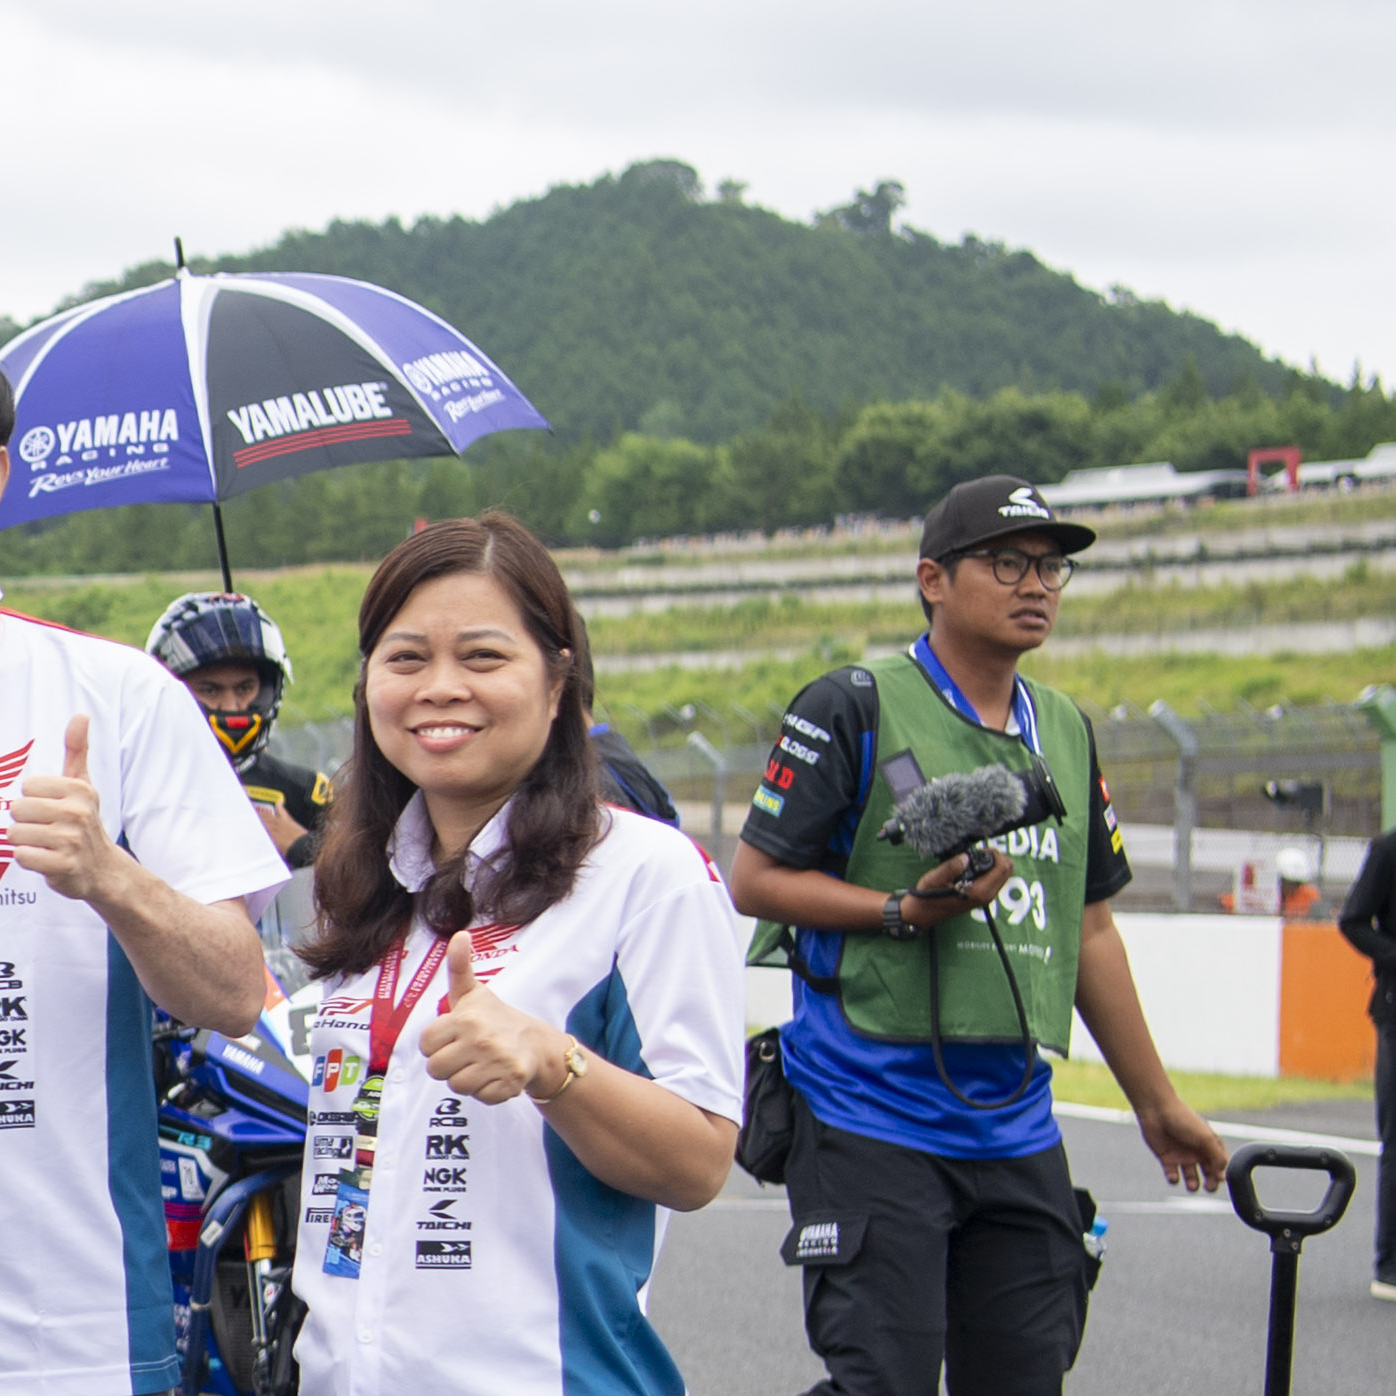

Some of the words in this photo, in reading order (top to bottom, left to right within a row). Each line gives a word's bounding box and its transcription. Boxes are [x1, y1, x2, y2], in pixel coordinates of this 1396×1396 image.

[413, 350, 490, 387] YAMAHA
[227, 382, 393, 444] YAMALUBE
[57, 409, 179, 453] YAMAHA
[31, 443, 169, 471] RACING
[29, 469, 84, 498] Revs
[125, 457, 169, 475] Heart
[975, 825, 1059, 864] EDIA
[470, 944, 520, 963] ONDA
[222, 1043, 265, 1075] YAMAHA
[429, 1117, 468, 1128] RCB
[426, 1134, 470, 1155] RK
[423, 1167, 467, 1185] NGK
[306, 1207, 335, 1223] PIRE
[416, 1221, 473, 1230] TAICHI
[416, 1254, 472, 1264] ASHUKA
